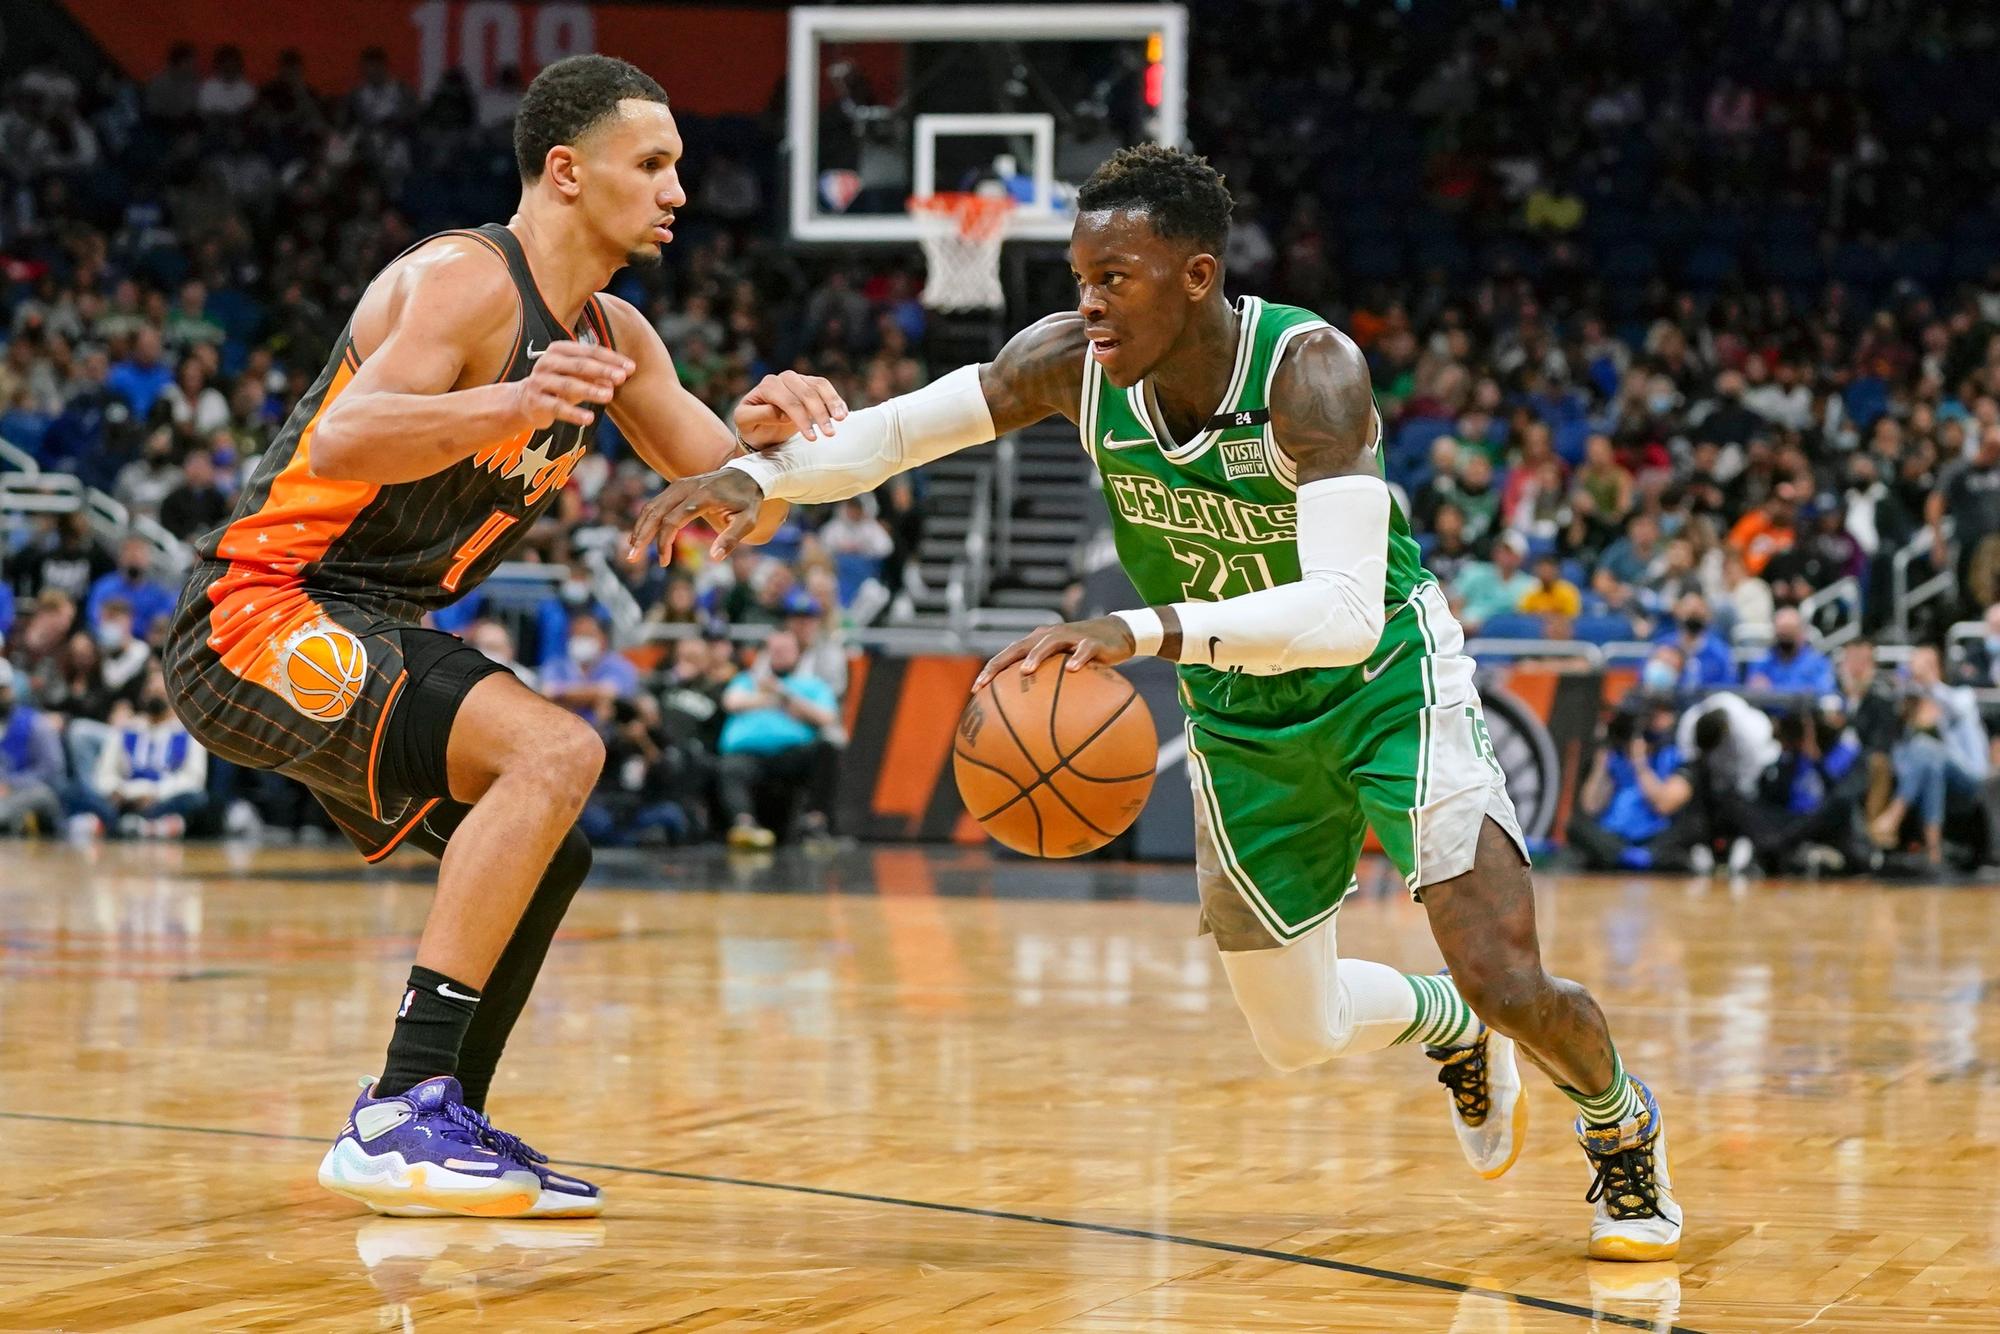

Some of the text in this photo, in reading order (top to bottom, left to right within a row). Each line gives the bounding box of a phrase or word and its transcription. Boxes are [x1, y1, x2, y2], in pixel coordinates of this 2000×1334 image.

[1235, 411, 1252, 426] 24
[1223, 442, 1263, 462] VISTA
[1228, 463, 1255, 476] PRINT
[1107, 473, 1298, 545] CELTICS
[440, 508, 520, 593] 4
[1164, 535, 1275, 603] 71
